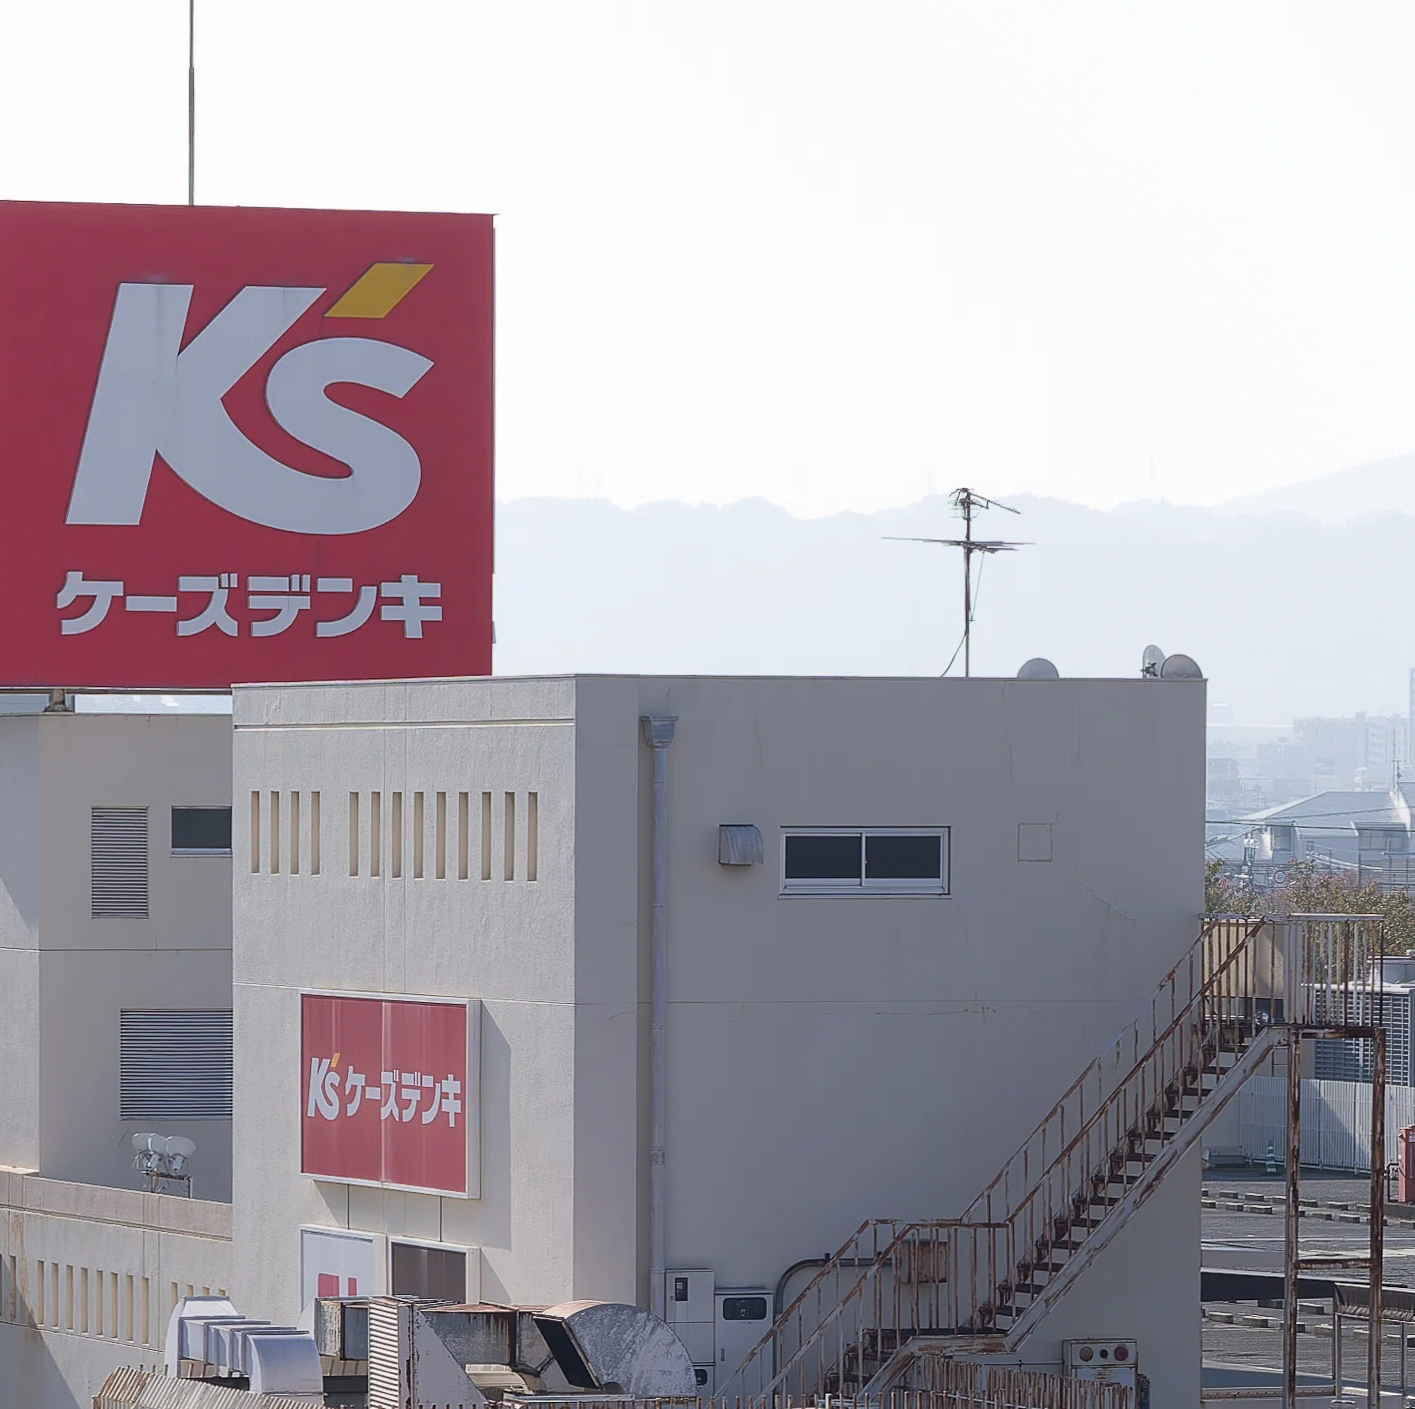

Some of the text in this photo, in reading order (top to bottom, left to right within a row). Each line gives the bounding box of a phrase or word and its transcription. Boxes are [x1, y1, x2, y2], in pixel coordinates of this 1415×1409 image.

[65, 262, 434, 535] K's
[57, 571, 442, 639] ケーズデンキ
[345, 1065, 462, 1128] ケーズデンキ
